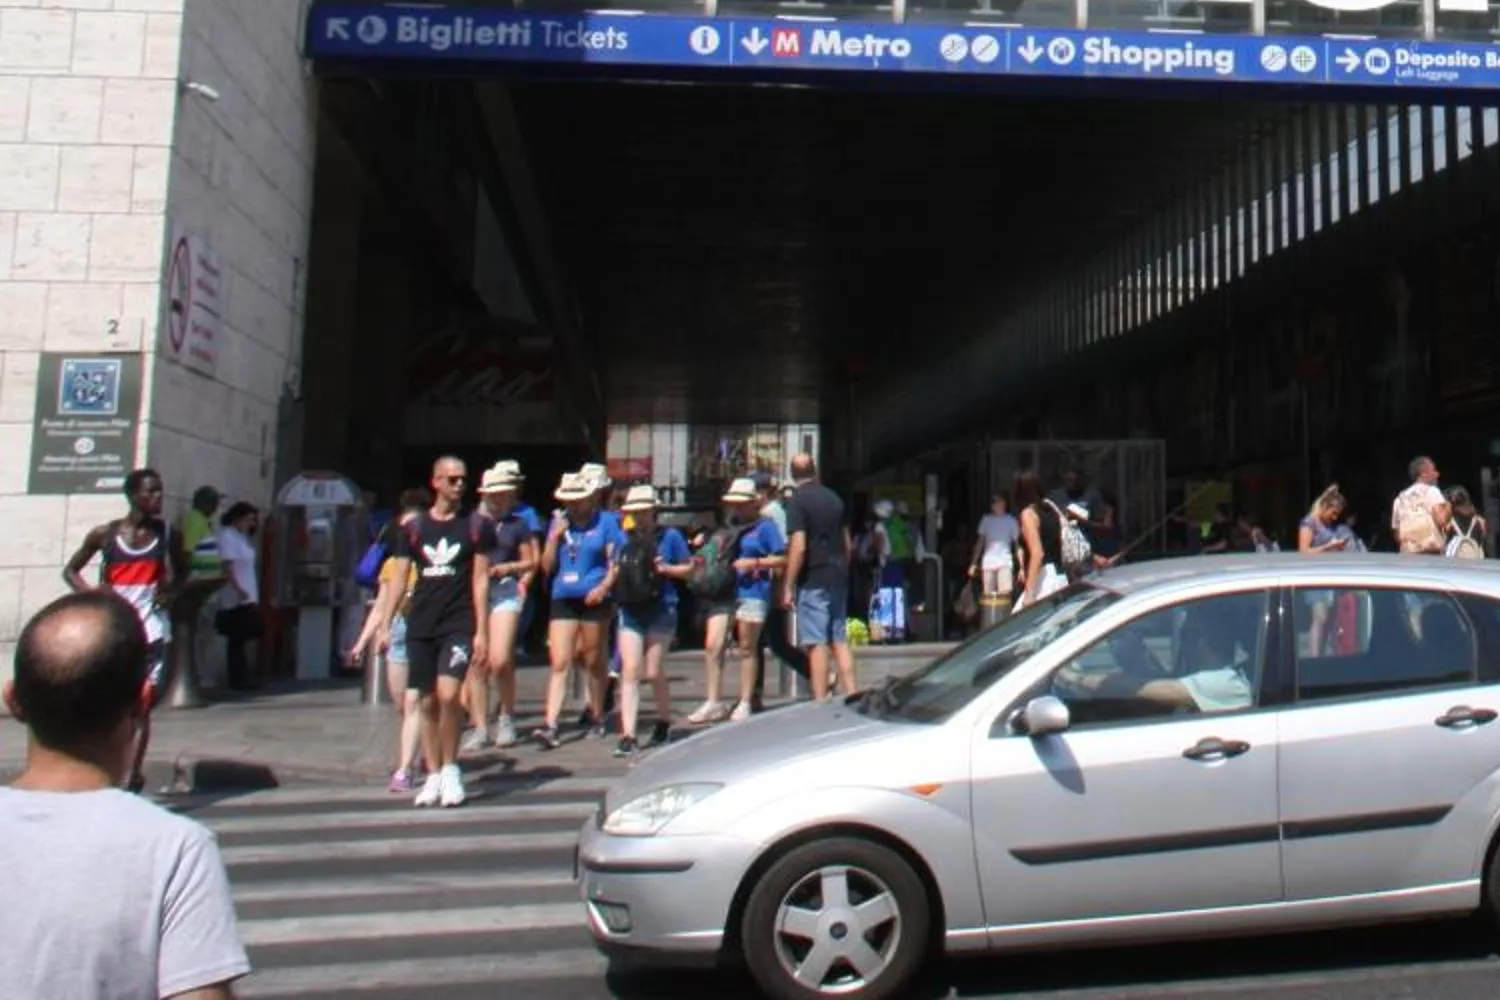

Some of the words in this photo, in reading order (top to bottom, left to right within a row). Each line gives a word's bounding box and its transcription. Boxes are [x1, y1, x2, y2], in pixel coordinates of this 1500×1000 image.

[397, 16, 531, 50] Biglietti
[540, 20, 628, 50] Tickets
[776, 31, 799, 52] M
[810, 29, 911, 57] Metro
[1083, 36, 1234, 75] Shopping
[1395, 48, 1481, 69] Deposito
[108, 319, 120, 335] 2
